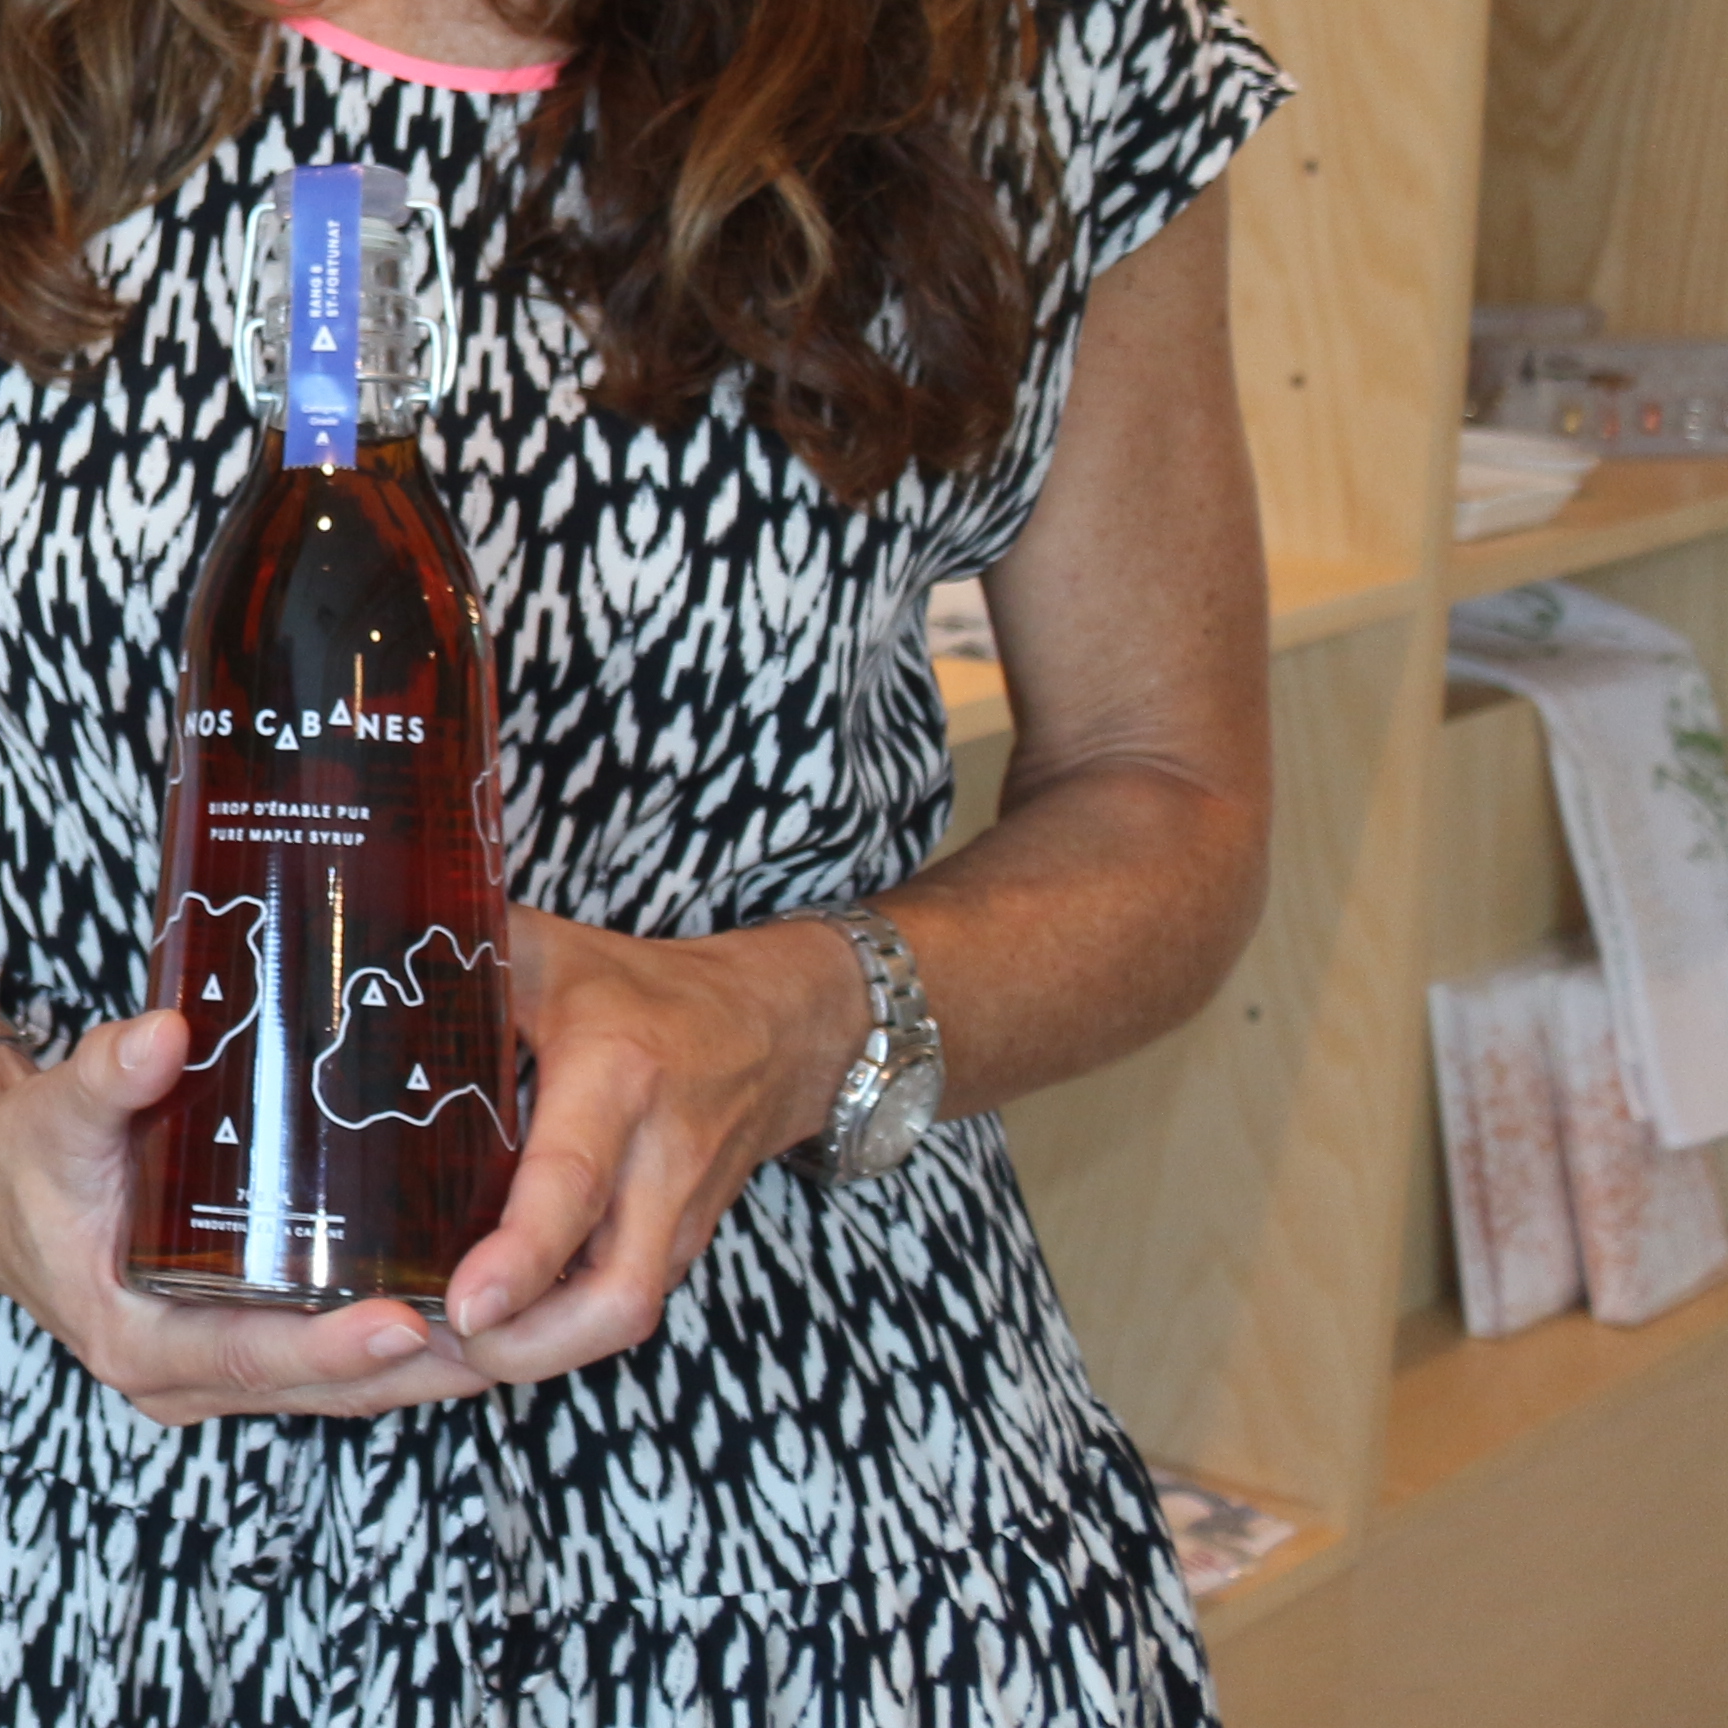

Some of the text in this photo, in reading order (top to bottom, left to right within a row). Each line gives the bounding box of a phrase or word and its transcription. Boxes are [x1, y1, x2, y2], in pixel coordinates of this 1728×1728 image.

[309, 279, 323, 319] RANG
[315, 431, 330, 447] A
[184, 697, 426, 751] NOS CABANES
[208, 799, 371, 821] SIROP D'ÉRABLE PUR
[209, 827, 366, 846] PURE MAPLE SYRUP
